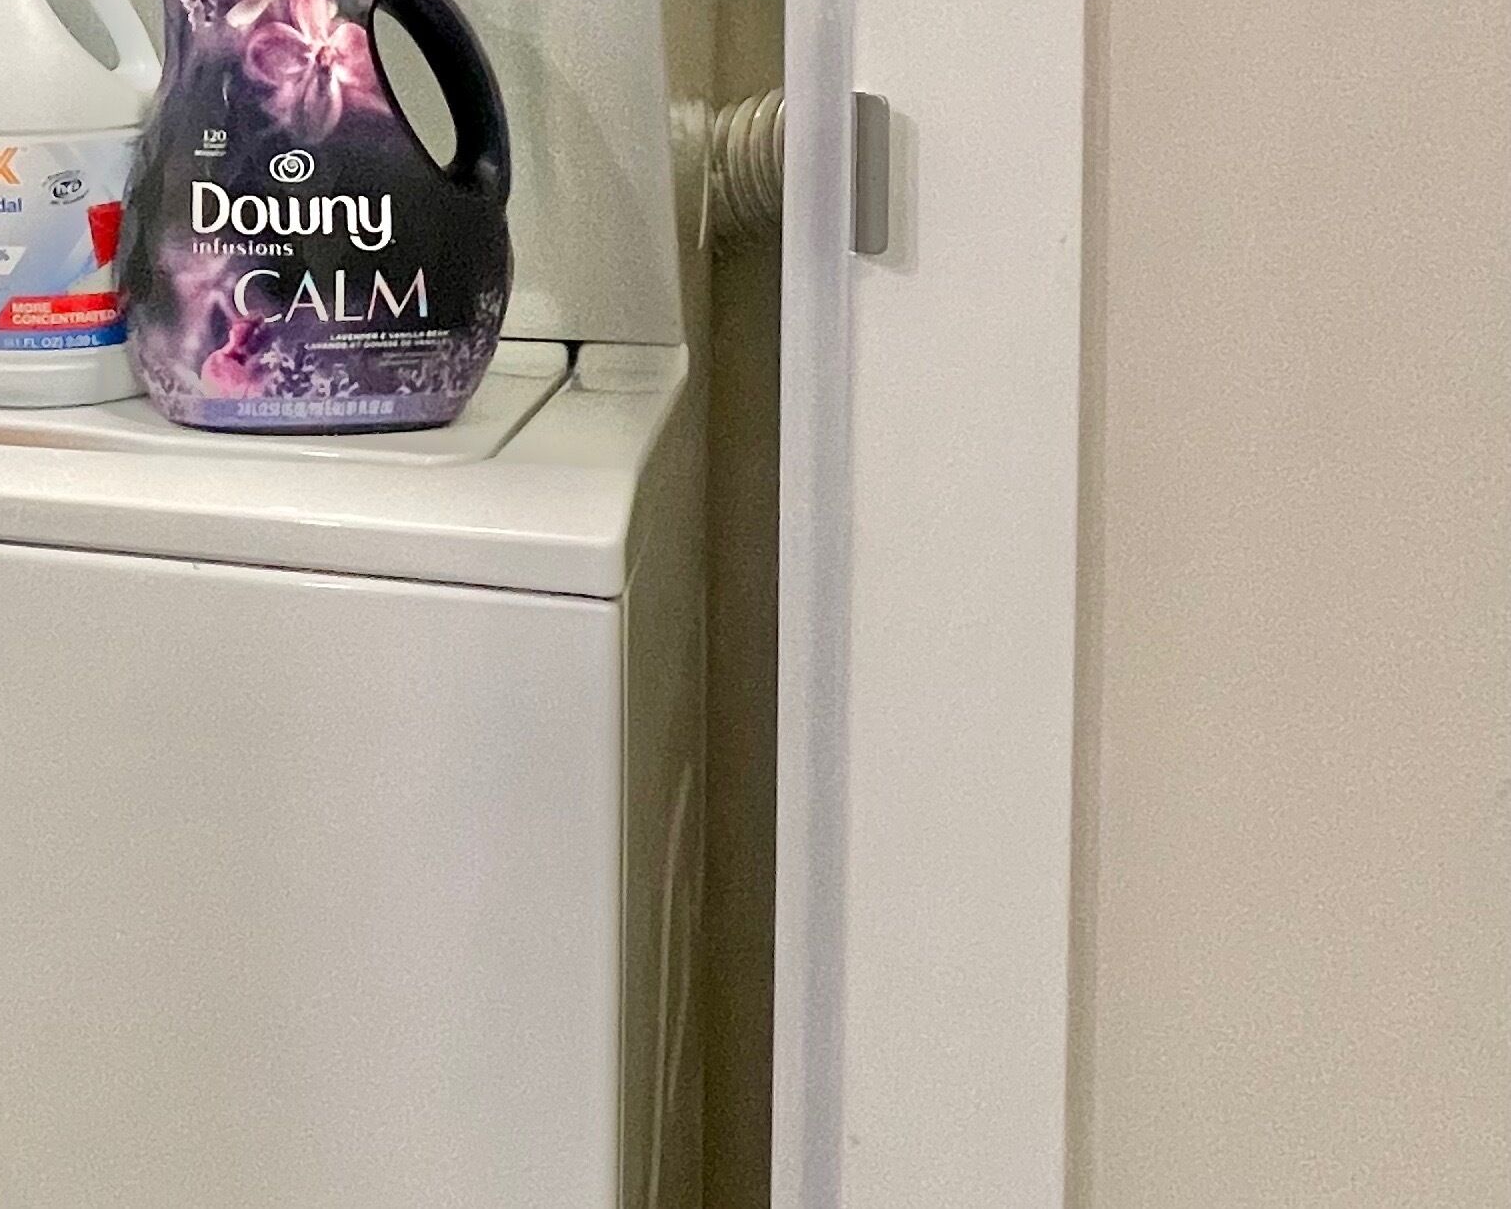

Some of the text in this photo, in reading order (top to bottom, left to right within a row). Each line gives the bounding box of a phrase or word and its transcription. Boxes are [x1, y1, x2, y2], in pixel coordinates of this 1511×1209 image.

[203, 129, 227, 142] 120
[191, 180, 392, 252] Downy
[192, 237, 294, 257] infusions
[233, 267, 429, 324] CALM
[11, 302, 53, 314] MORE
[11, 309, 117, 326] CONCENTRATED
